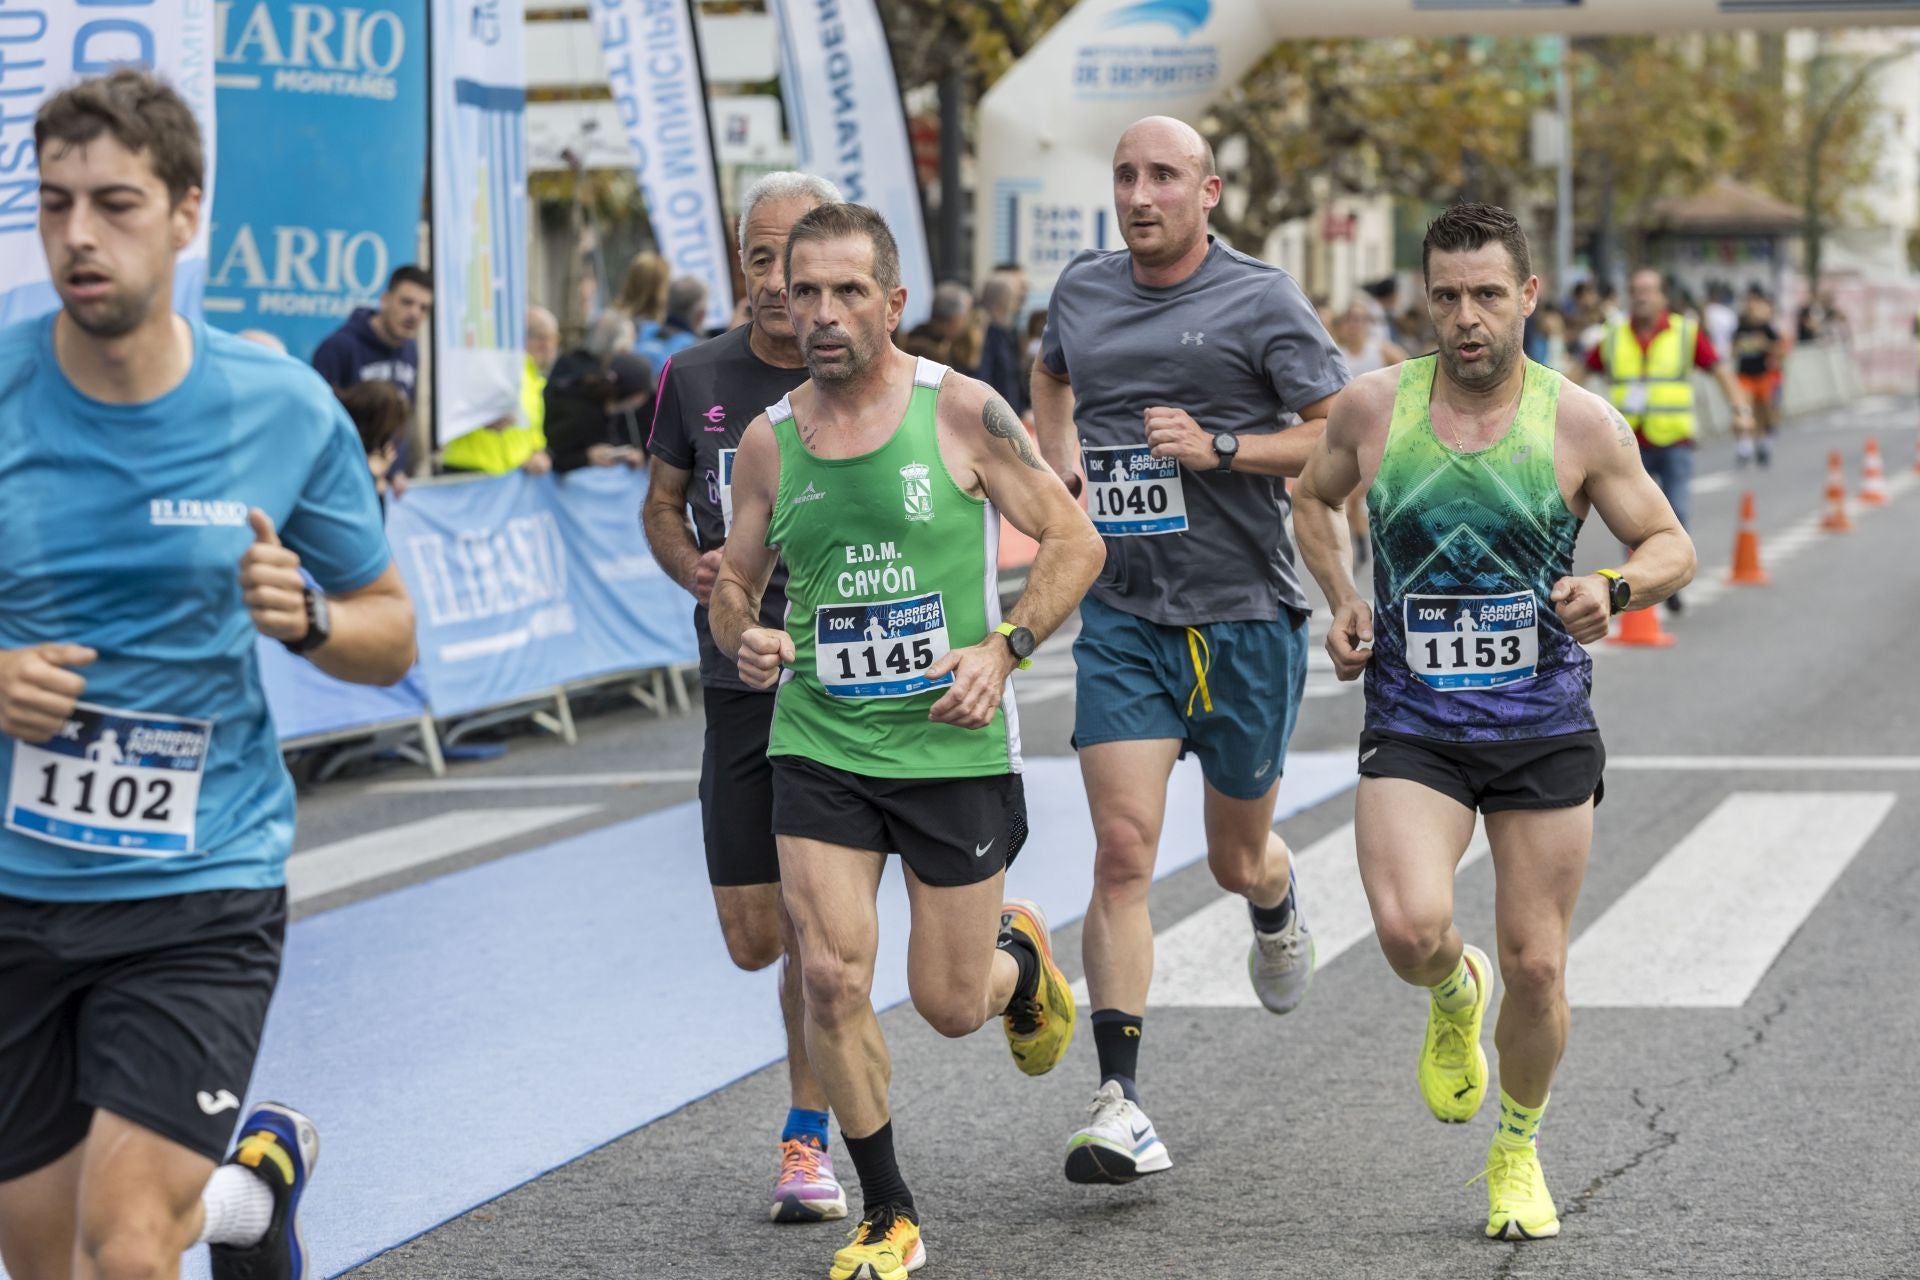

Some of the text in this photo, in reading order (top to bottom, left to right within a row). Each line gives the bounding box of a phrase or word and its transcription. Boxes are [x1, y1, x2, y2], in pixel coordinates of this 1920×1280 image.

[0, 0, 47, 234] INSTITU
[1090, 460, 1104, 471] 10K
[1129, 460, 1175, 472] POPULAR
[1160, 469, 1175, 478] DM
[1096, 484, 1168, 517] 1040
[845, 541, 902, 564] E.D.M.
[837, 561, 916, 598] CAYÓN
[888, 600, 940, 621] CARRERA
[1418, 608, 1447, 621] 10K
[1479, 609, 1533, 622] POPULAR
[1480, 601, 1533, 614] CARRERA
[828, 616, 856, 631] 10K
[888, 610, 940, 629] POPULAR
[925, 620, 940, 631] DM
[1515, 618, 1533, 629] DM
[836, 637, 934, 680] 1145
[1425, 635, 1521, 669] 1153
[39, 761, 173, 822] 1102
